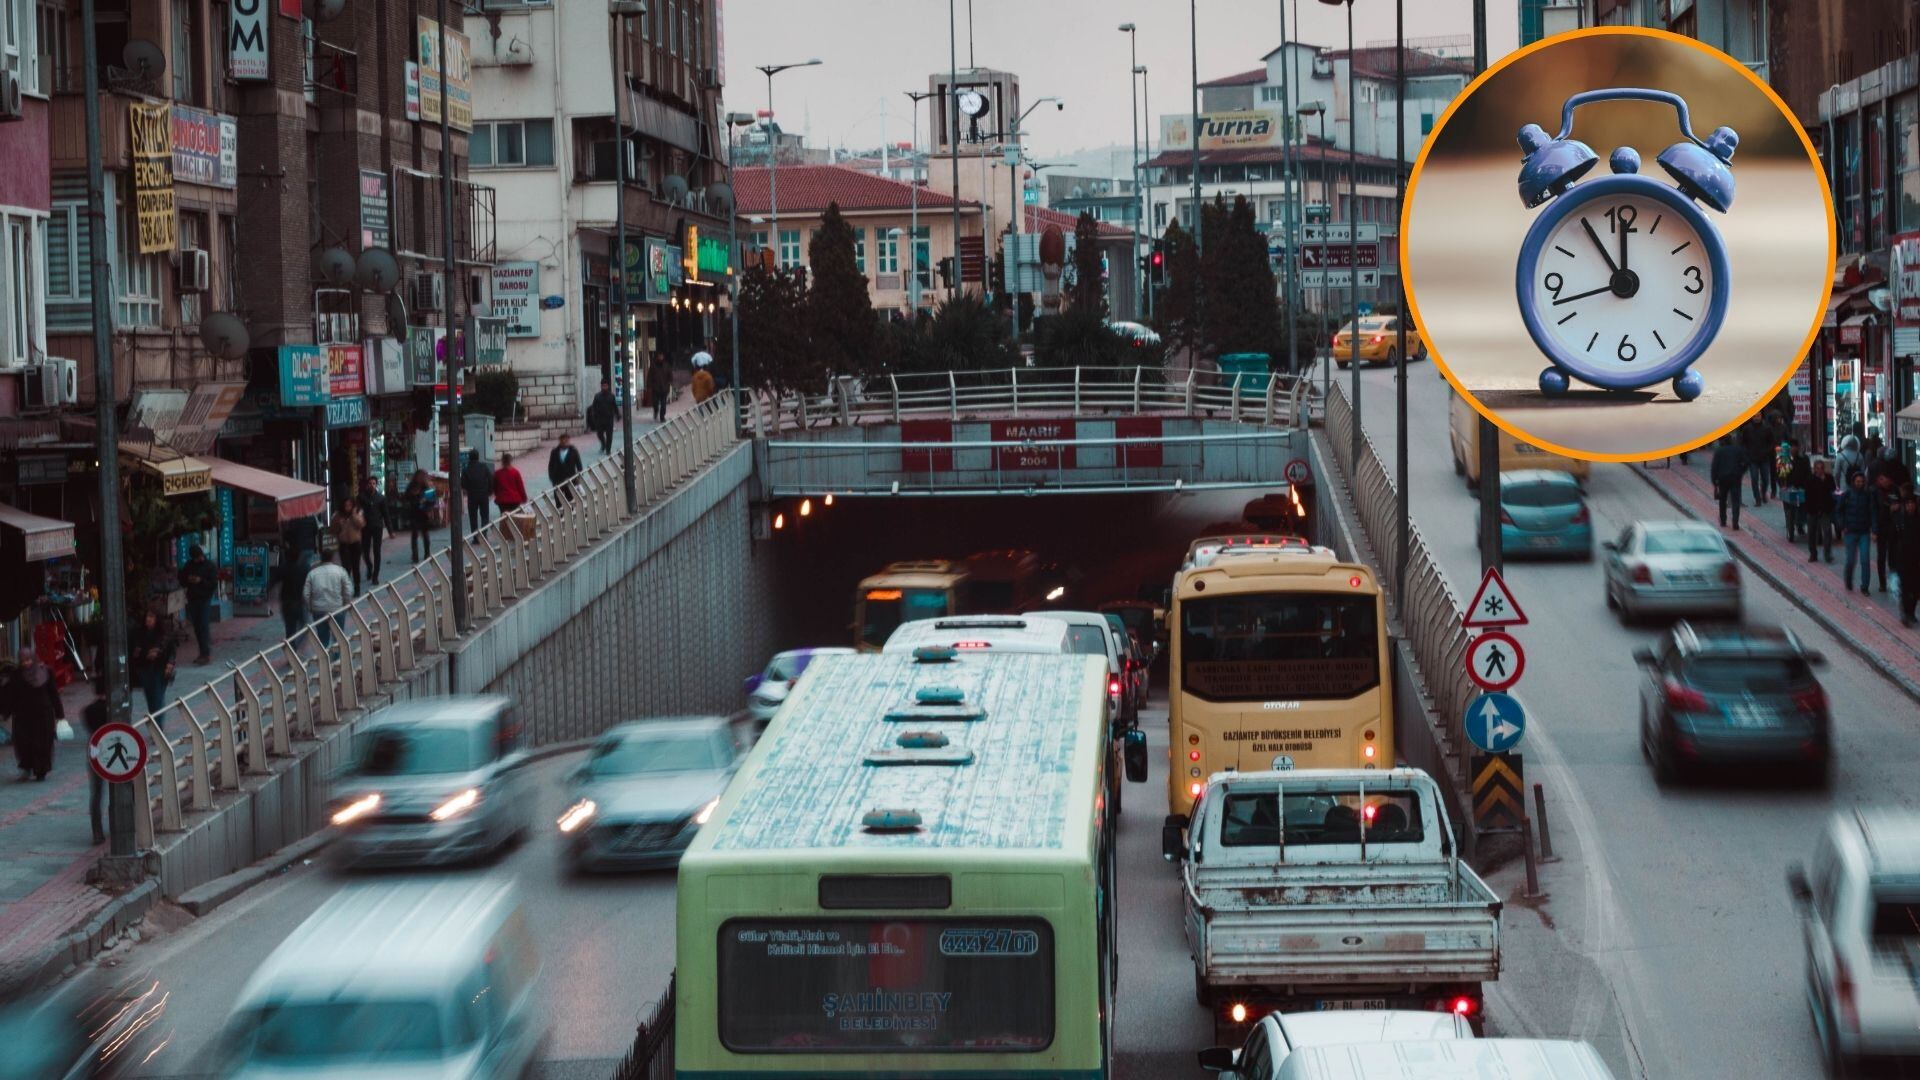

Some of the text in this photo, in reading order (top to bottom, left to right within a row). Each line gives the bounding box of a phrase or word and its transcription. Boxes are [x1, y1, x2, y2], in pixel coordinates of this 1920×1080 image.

[1197, 117, 1270, 137] Turna
[1604, 204, 1638, 233] 12
[1317, 229, 1362, 239] Karagz
[1340, 256, 1376, 265] (Cstle)
[493, 267, 533, 278] GAZİANTEP
[1683, 265, 1704, 294] 3
[499, 281, 529, 291] BAROSU
[1544, 272, 1564, 300] 9
[1617, 334, 1637, 361] 6
[328, 350, 345, 374] GAP
[1006, 424, 1062, 438] MAARİF
[1019, 456, 1048, 467] 2004
[1263, 702, 1301, 710] OTOKAR
[1223, 727, 1341, 741] GAZİANTEP BÜYÜKŞEHİR BELEDİYESİ
[1252, 743, 1267, 752] ÖZEL
[1268, 743, 1283, 752] HALK
[944, 929, 1034, 953] 444 27 01
[822, 987, 952, 1018] ŞAHİNBEY
[839, 1014, 937, 1031] BELEDİYESİ
